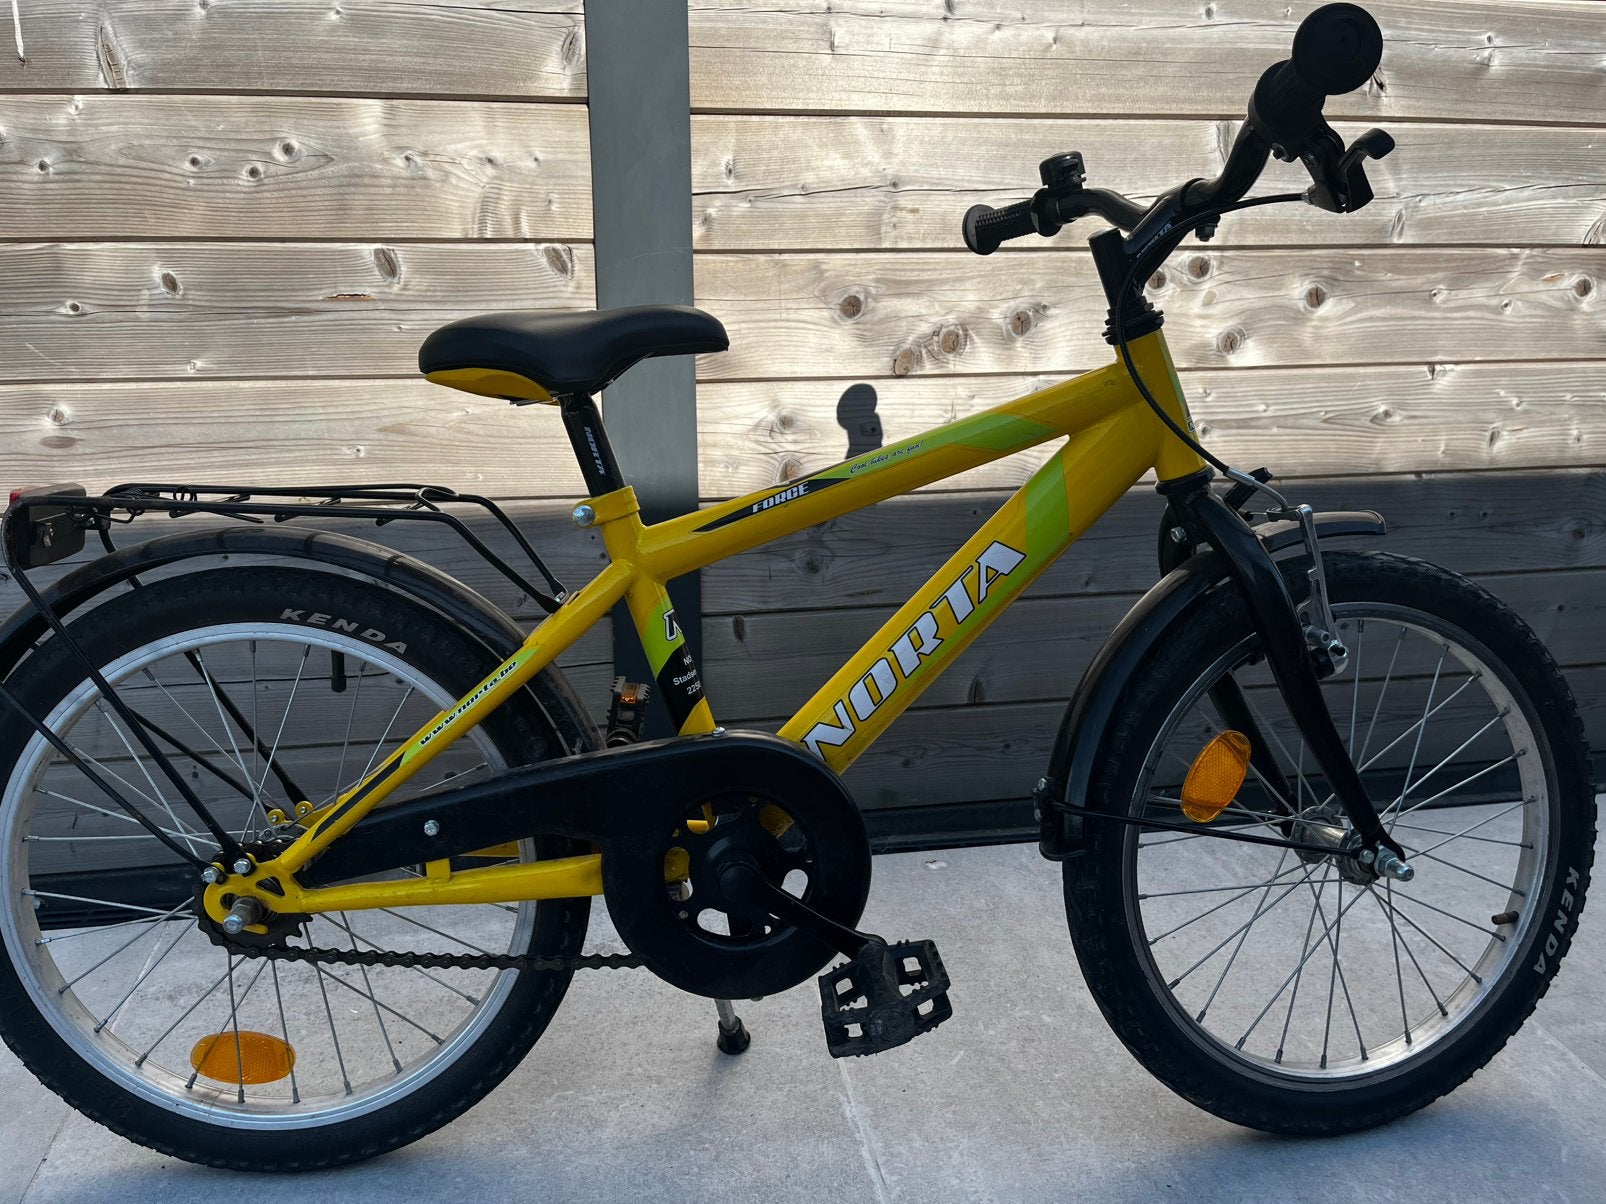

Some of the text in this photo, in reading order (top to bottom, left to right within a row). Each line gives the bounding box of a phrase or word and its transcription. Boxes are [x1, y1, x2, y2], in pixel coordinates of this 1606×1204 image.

[583, 426, 605, 476] NORTA
[850, 439, 924, 473] Cool bikes are fun!
[752, 481, 809, 513] FORCE
[279, 608, 408, 655] KENDA
[800, 540, 1027, 762] NORTA
[419, 660, 517, 746] www.norta.be
[1533, 866, 1580, 975] KENDA
